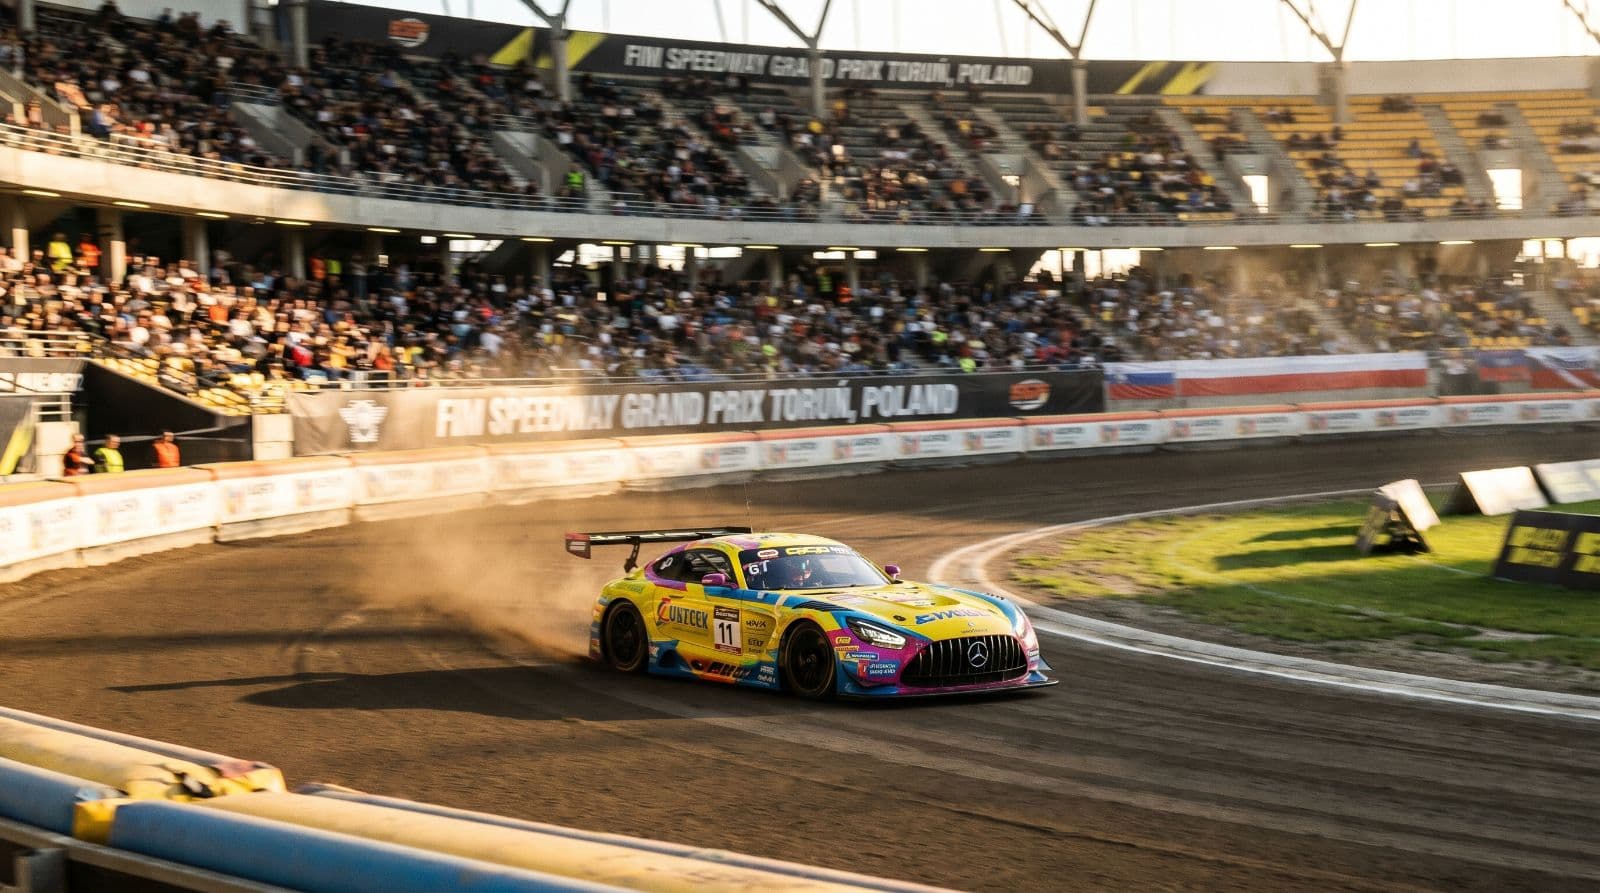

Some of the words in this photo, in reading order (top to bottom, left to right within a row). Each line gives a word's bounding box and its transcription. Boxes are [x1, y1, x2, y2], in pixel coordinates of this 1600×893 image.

[624, 44, 664, 69] FIM
[665, 47, 768, 75] SPEEDWAY
[769, 55, 834, 79] GRAD
[836, 58, 884, 81] PRIX
[956, 63, 1033, 86] POLAND
[436, 399, 486, 437] FIM
[489, 395, 620, 435] SPEEDWAY
[622, 391, 705, 430] GRAND
[707, 388, 764, 424] PRIX
[861, 383, 959, 418] POLAND
[748, 559, 770, 575] GT
[718, 621, 734, 646] 11
